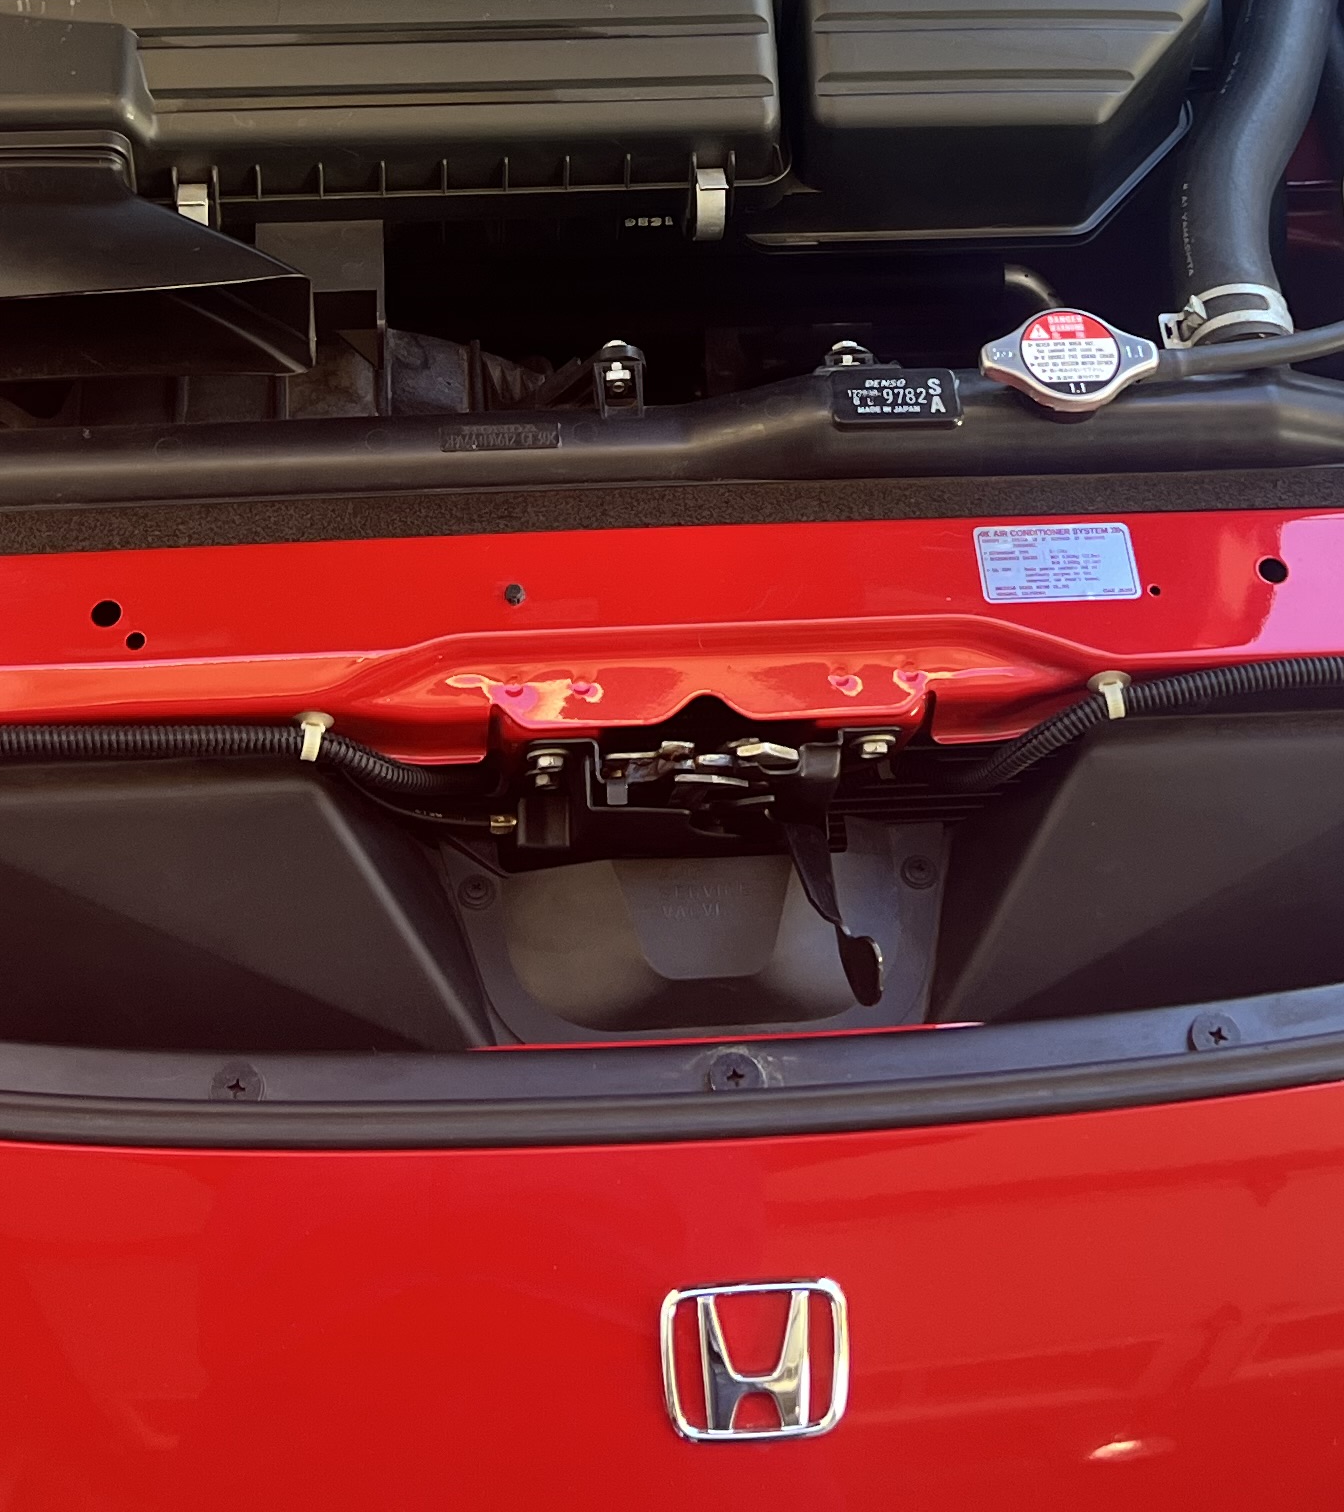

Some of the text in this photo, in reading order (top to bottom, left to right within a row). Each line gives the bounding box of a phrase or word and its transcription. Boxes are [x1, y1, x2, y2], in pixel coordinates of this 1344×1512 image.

[865, 379, 906, 388] DENSO
[1069, 383, 1087, 394] 1.1
[857, 406, 882, 414] MADE
[893, 405, 921, 413] JAPAN
[993, 527, 1109, 538] AIR CONDITIONER SYSTEM
